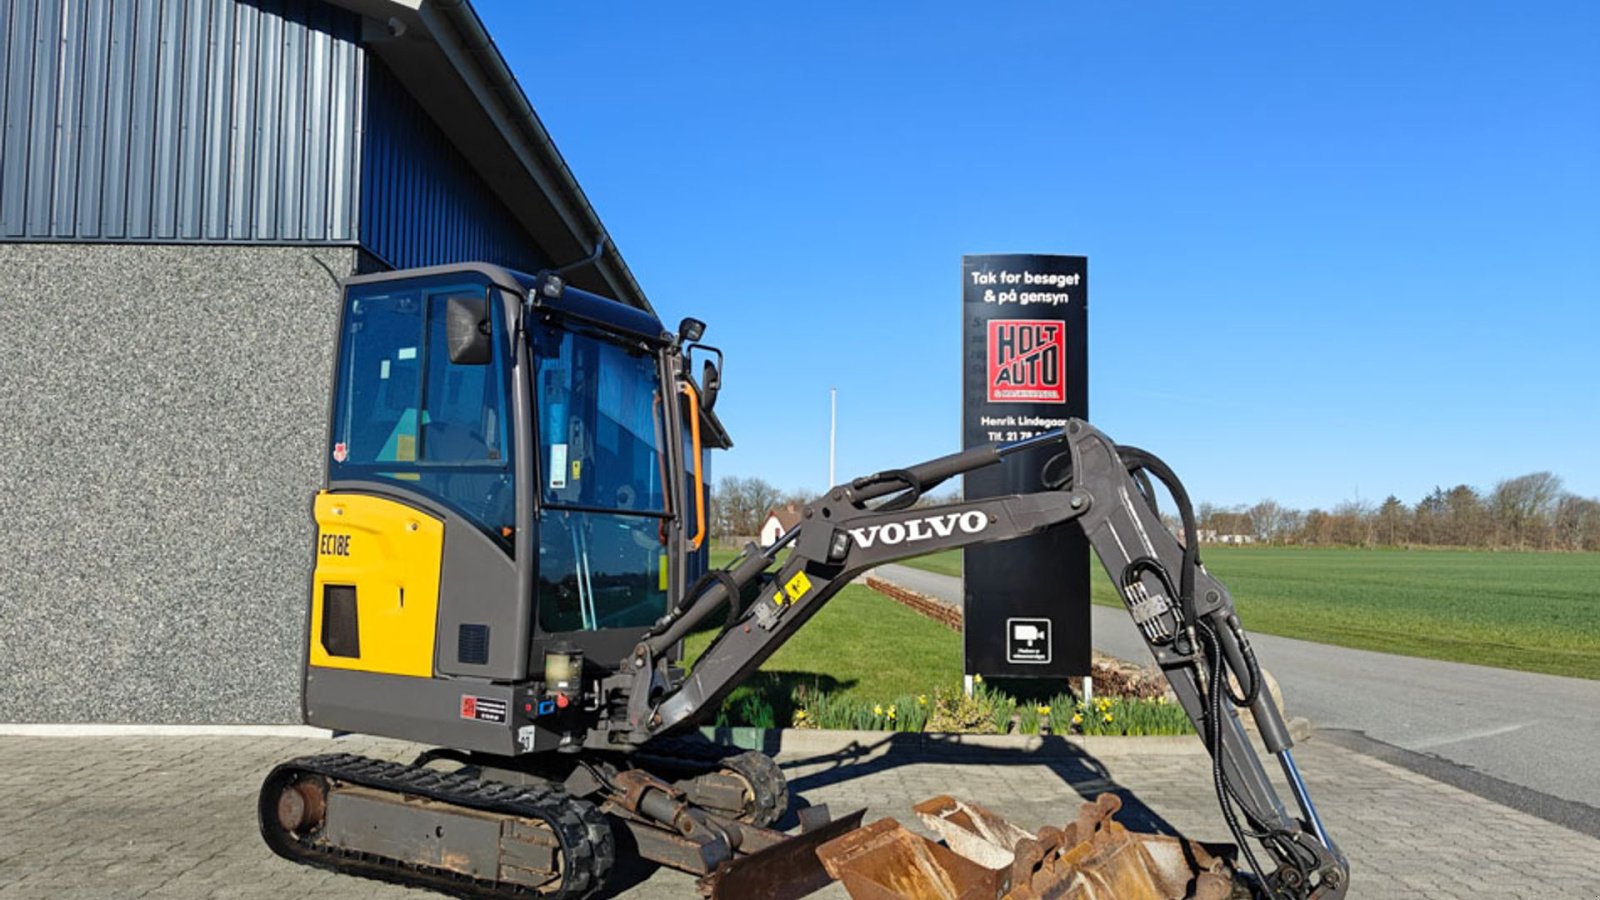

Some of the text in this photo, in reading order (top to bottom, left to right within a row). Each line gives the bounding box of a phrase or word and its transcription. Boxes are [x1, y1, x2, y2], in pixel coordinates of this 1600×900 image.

[971, 271, 1081, 288] Tak for besøget
[983, 288, 1069, 306] & på gensyn
[998, 324, 1058, 366] HOLT
[994, 343, 1058, 386] AUTO
[980, 416, 1067, 429] Henrik Lindegaar
[1006, 431, 1018, 441] 21
[847, 510, 989, 549] VOLVO
[320, 534, 352, 556] EC18E
